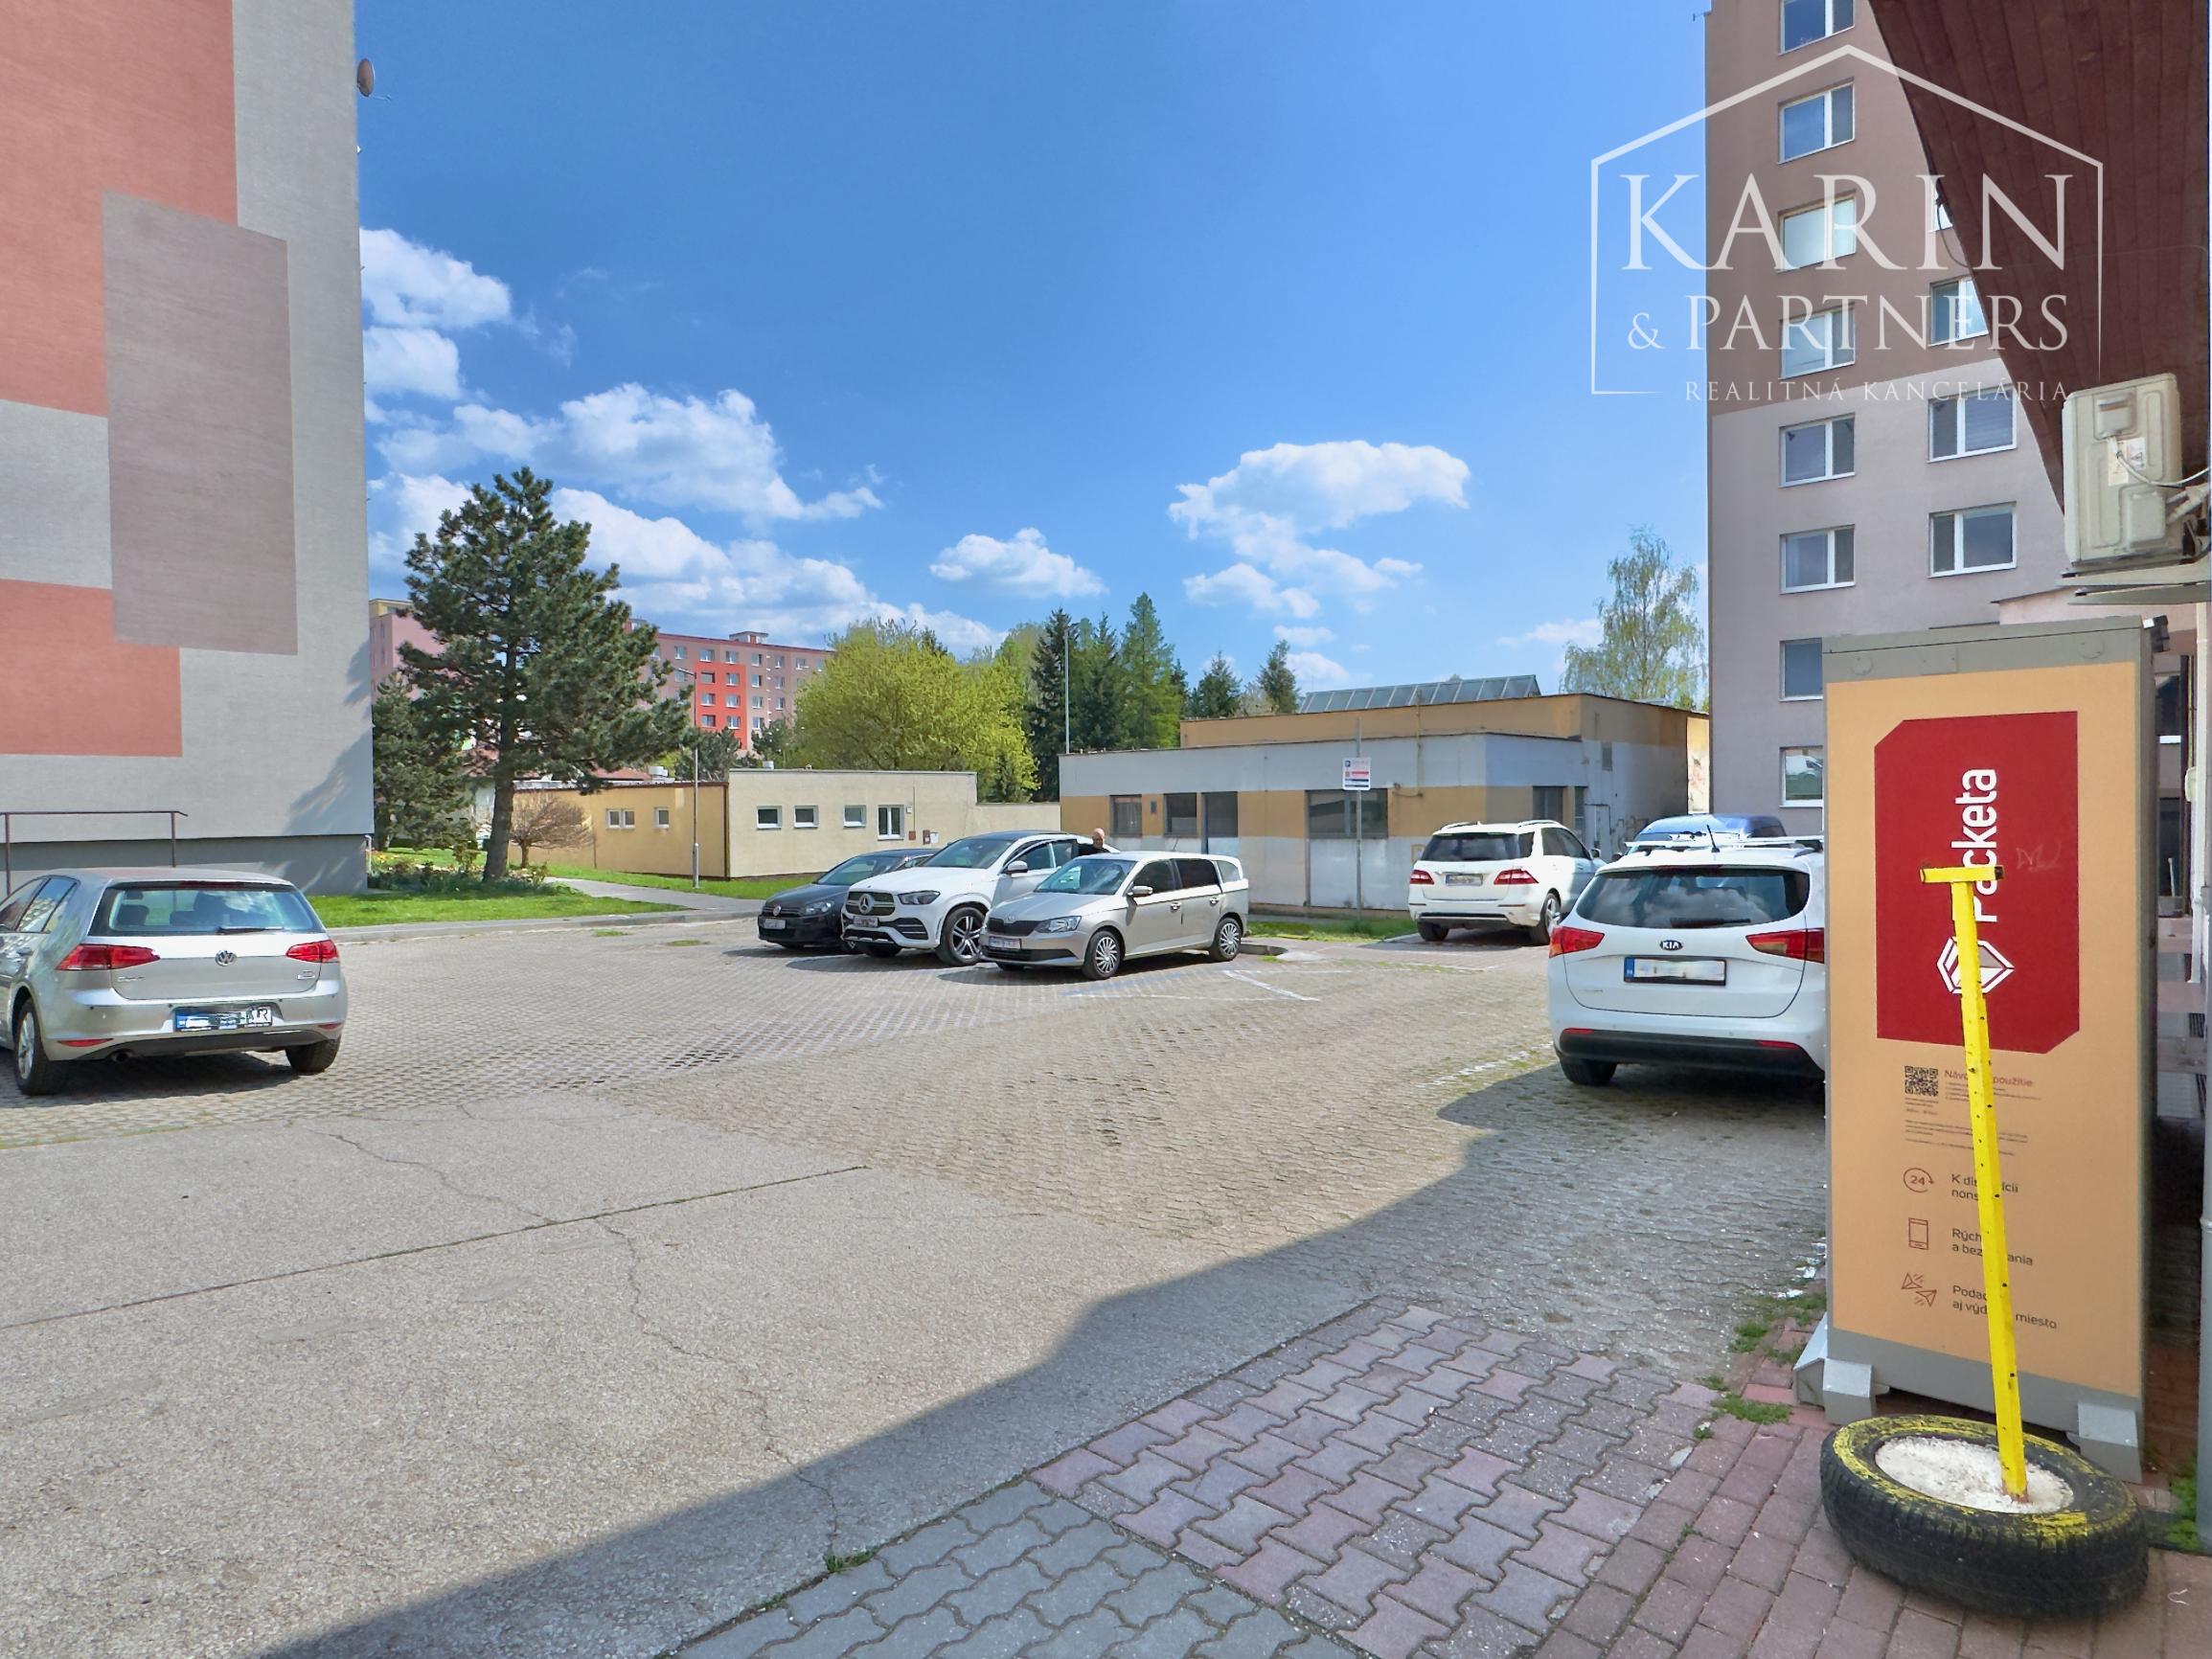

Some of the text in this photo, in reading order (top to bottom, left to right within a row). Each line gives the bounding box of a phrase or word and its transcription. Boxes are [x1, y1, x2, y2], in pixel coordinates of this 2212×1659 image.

[1910, 1175, 1926, 1186] 24
[1951, 1173, 1961, 1184] K
[1952, 1243, 1959, 1252] a
[2016, 1313, 2057, 1329] miesto
